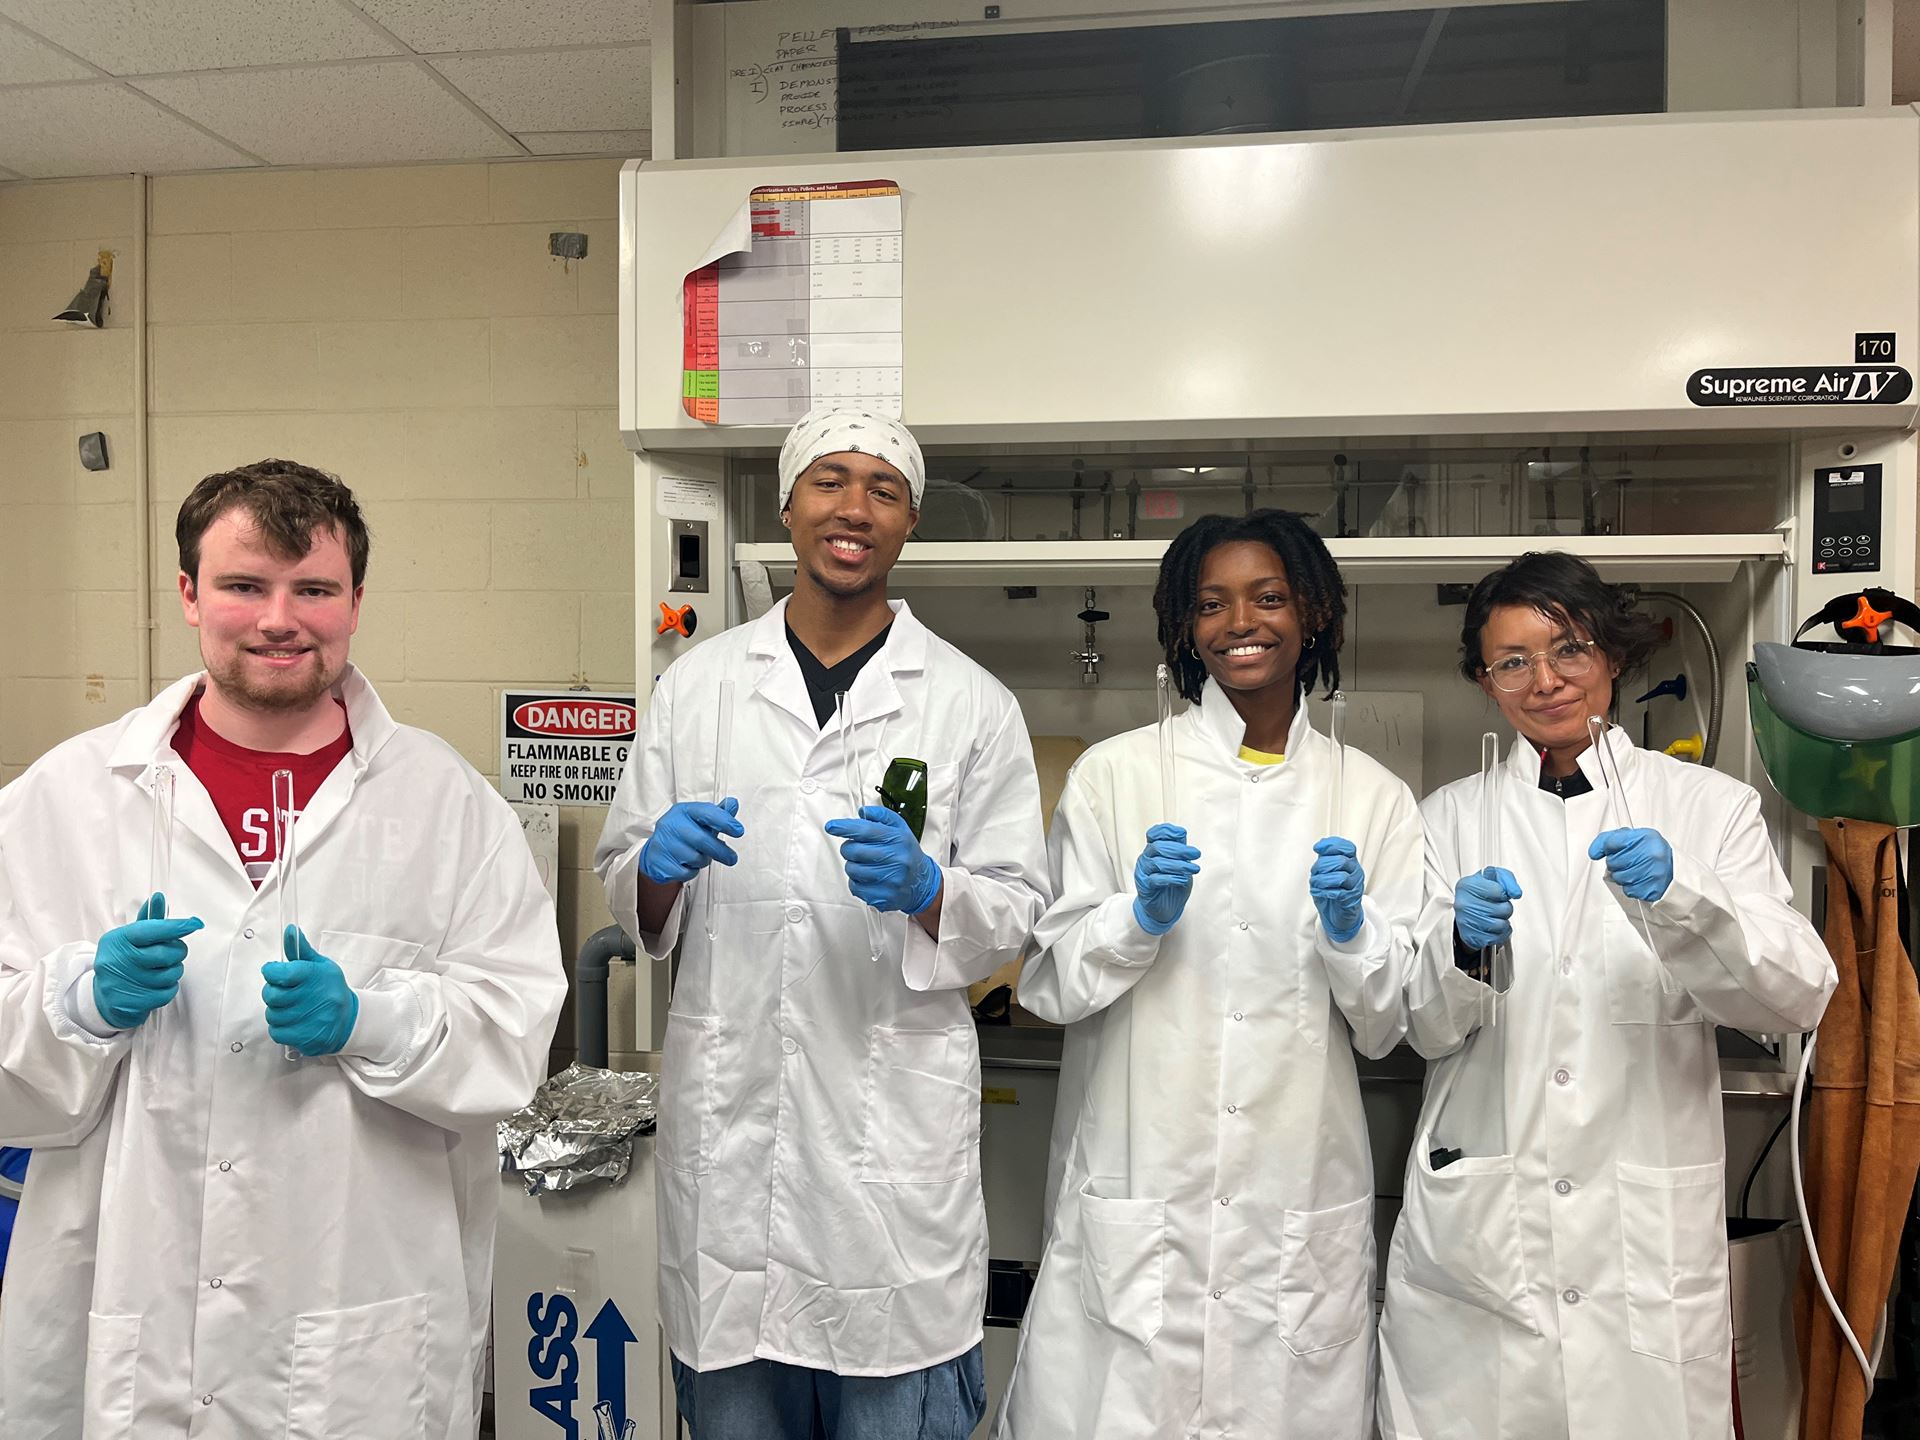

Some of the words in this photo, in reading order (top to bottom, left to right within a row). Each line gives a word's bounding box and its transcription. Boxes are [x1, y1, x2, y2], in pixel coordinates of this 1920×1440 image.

[1858, 340, 1892, 356] 170
[1700, 374, 1807, 398] Supreme
[1813, 372, 1849, 393] Air
[1768, 394, 1797, 402] SCIENTIFIC
[1797, 394, 1840, 402] CORPORATION
[527, 706, 632, 730] DANGER
[507, 743, 611, 762] FLAMMABLE
[616, 747, 628, 762] G
[510, 764, 536, 778] KEEP
[539, 765, 561, 779] FIRE
[564, 765, 579, 780] OR
[582, 766, 615, 781] FLAME
[523, 782, 547, 799] NO
[527, 1292, 579, 1440] ASS
